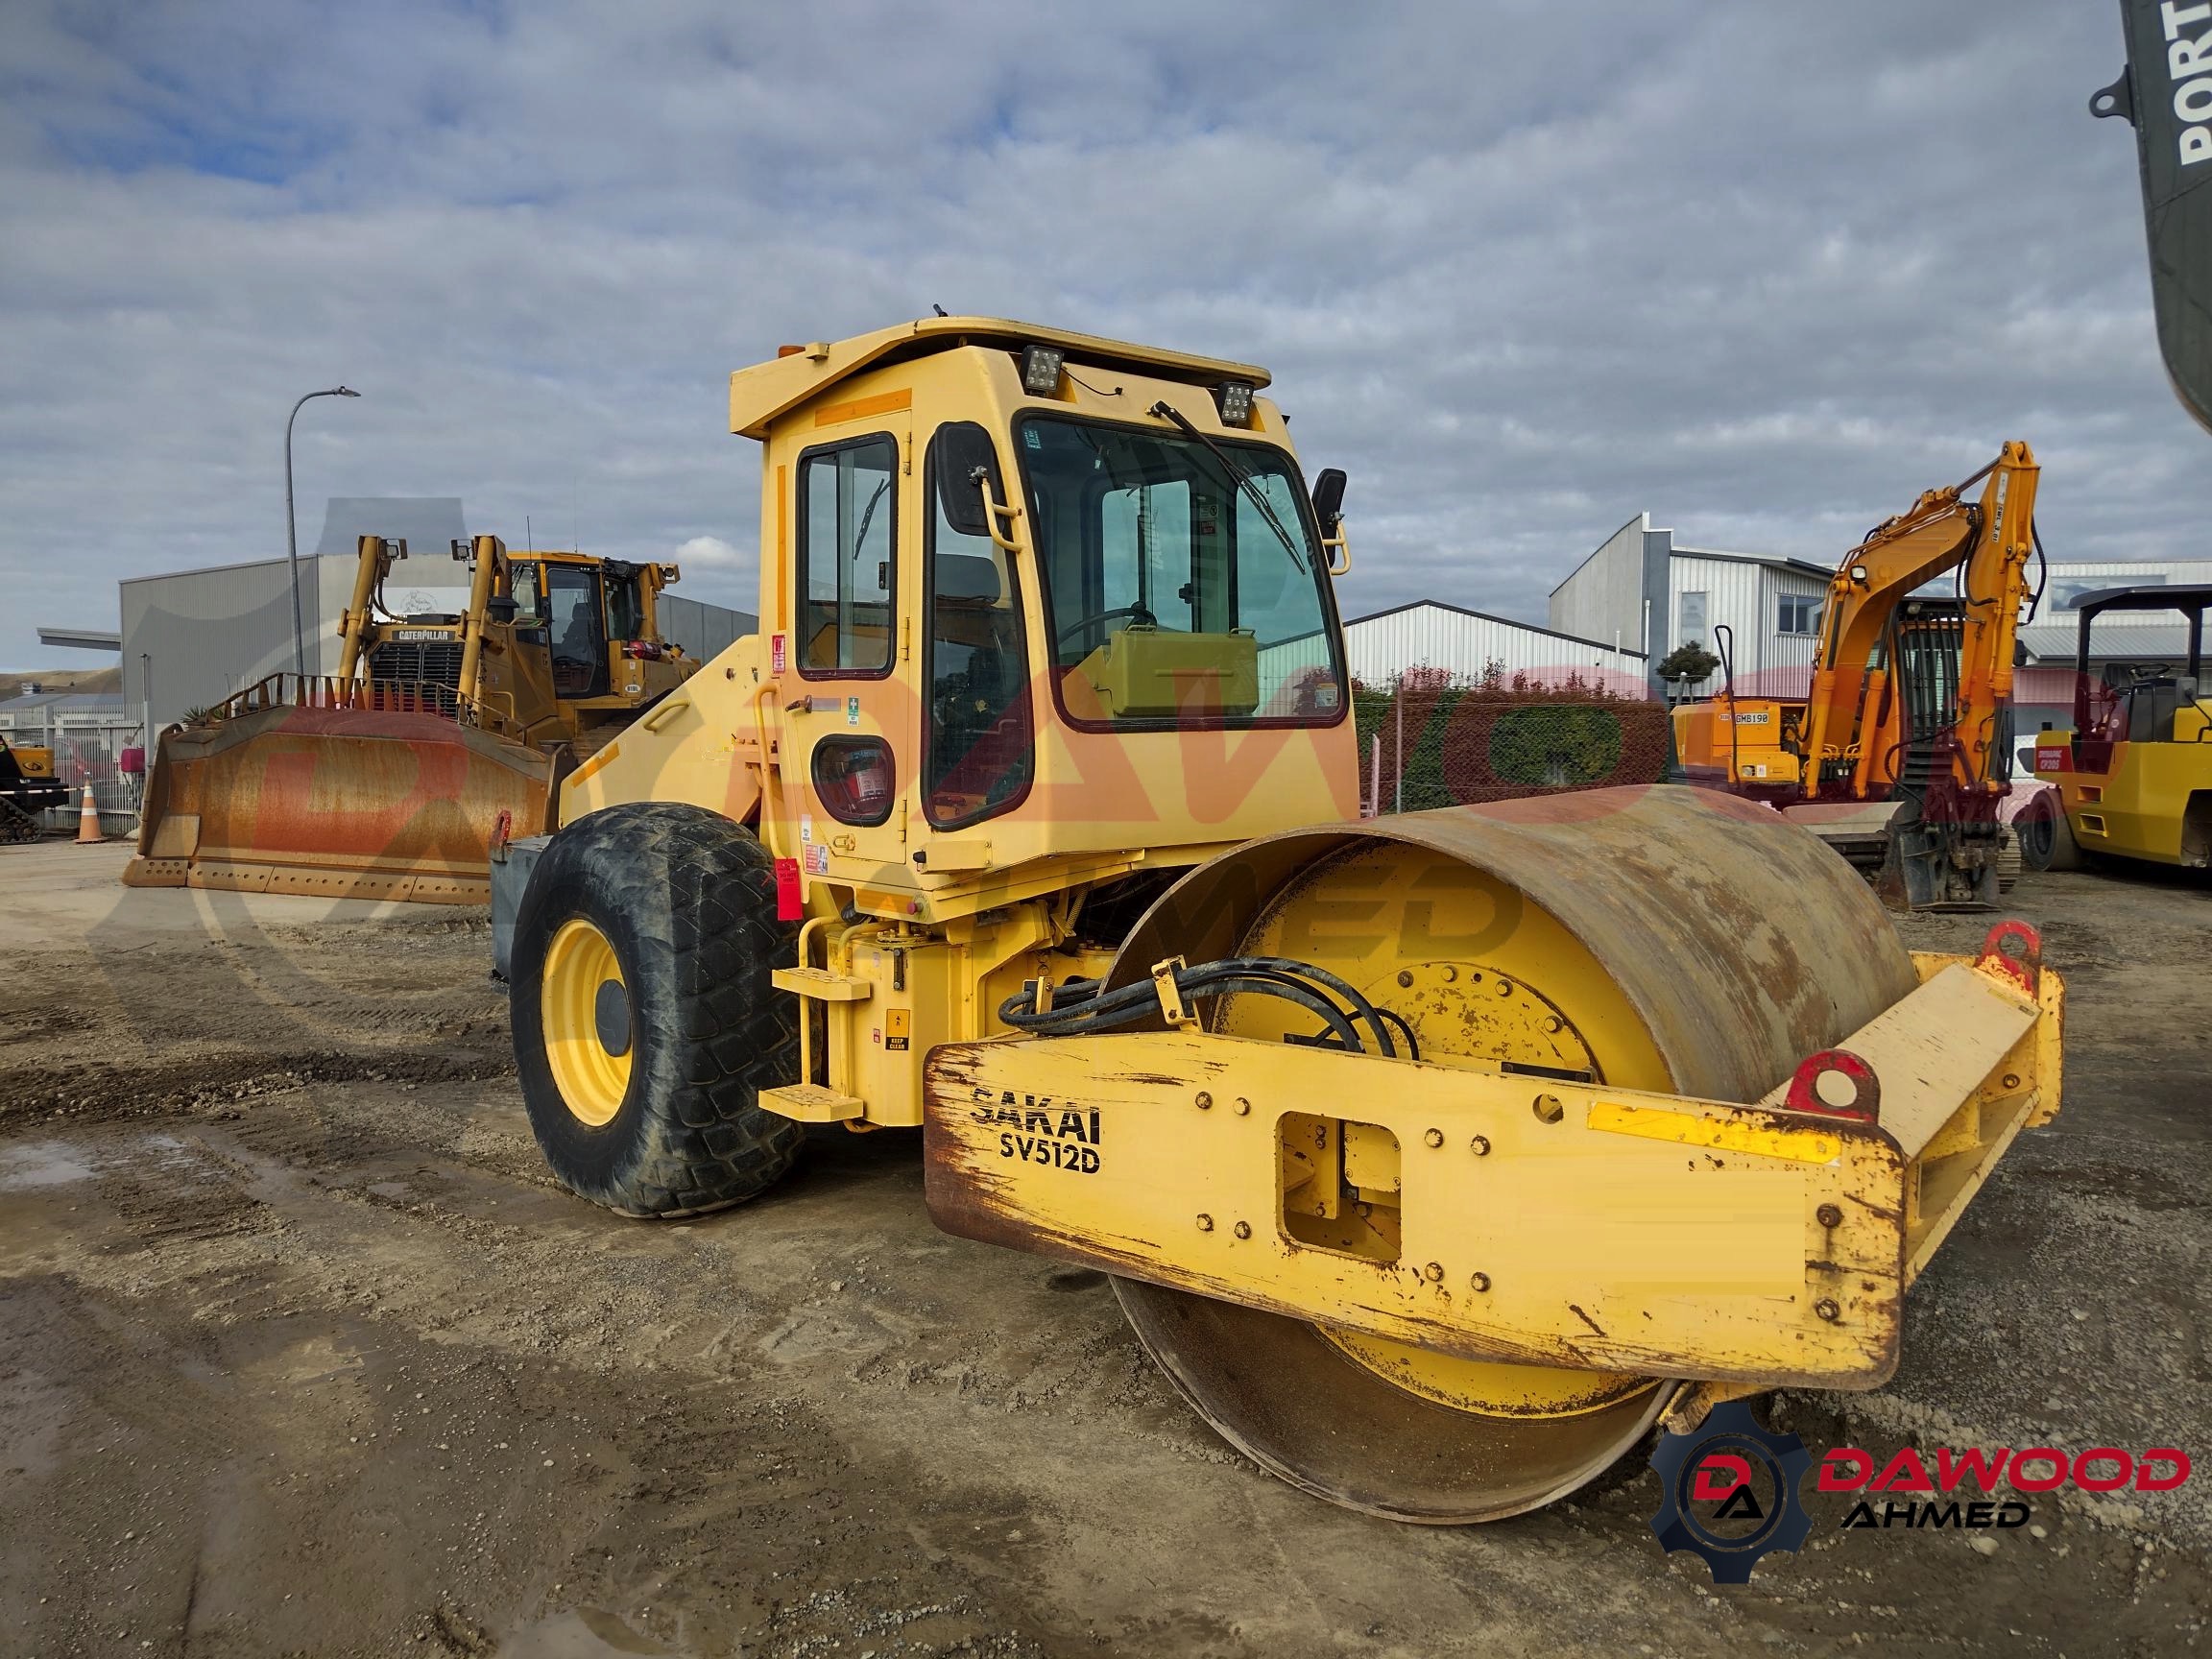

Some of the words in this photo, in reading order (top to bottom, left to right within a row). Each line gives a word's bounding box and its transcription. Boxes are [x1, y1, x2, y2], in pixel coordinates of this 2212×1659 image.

[398, 631, 448, 640] CATERPILLAR
[1736, 714, 1767, 723] GMB190
[970, 1087, 1100, 1145] SAKAI
[999, 1132, 1100, 1174] SV512D
